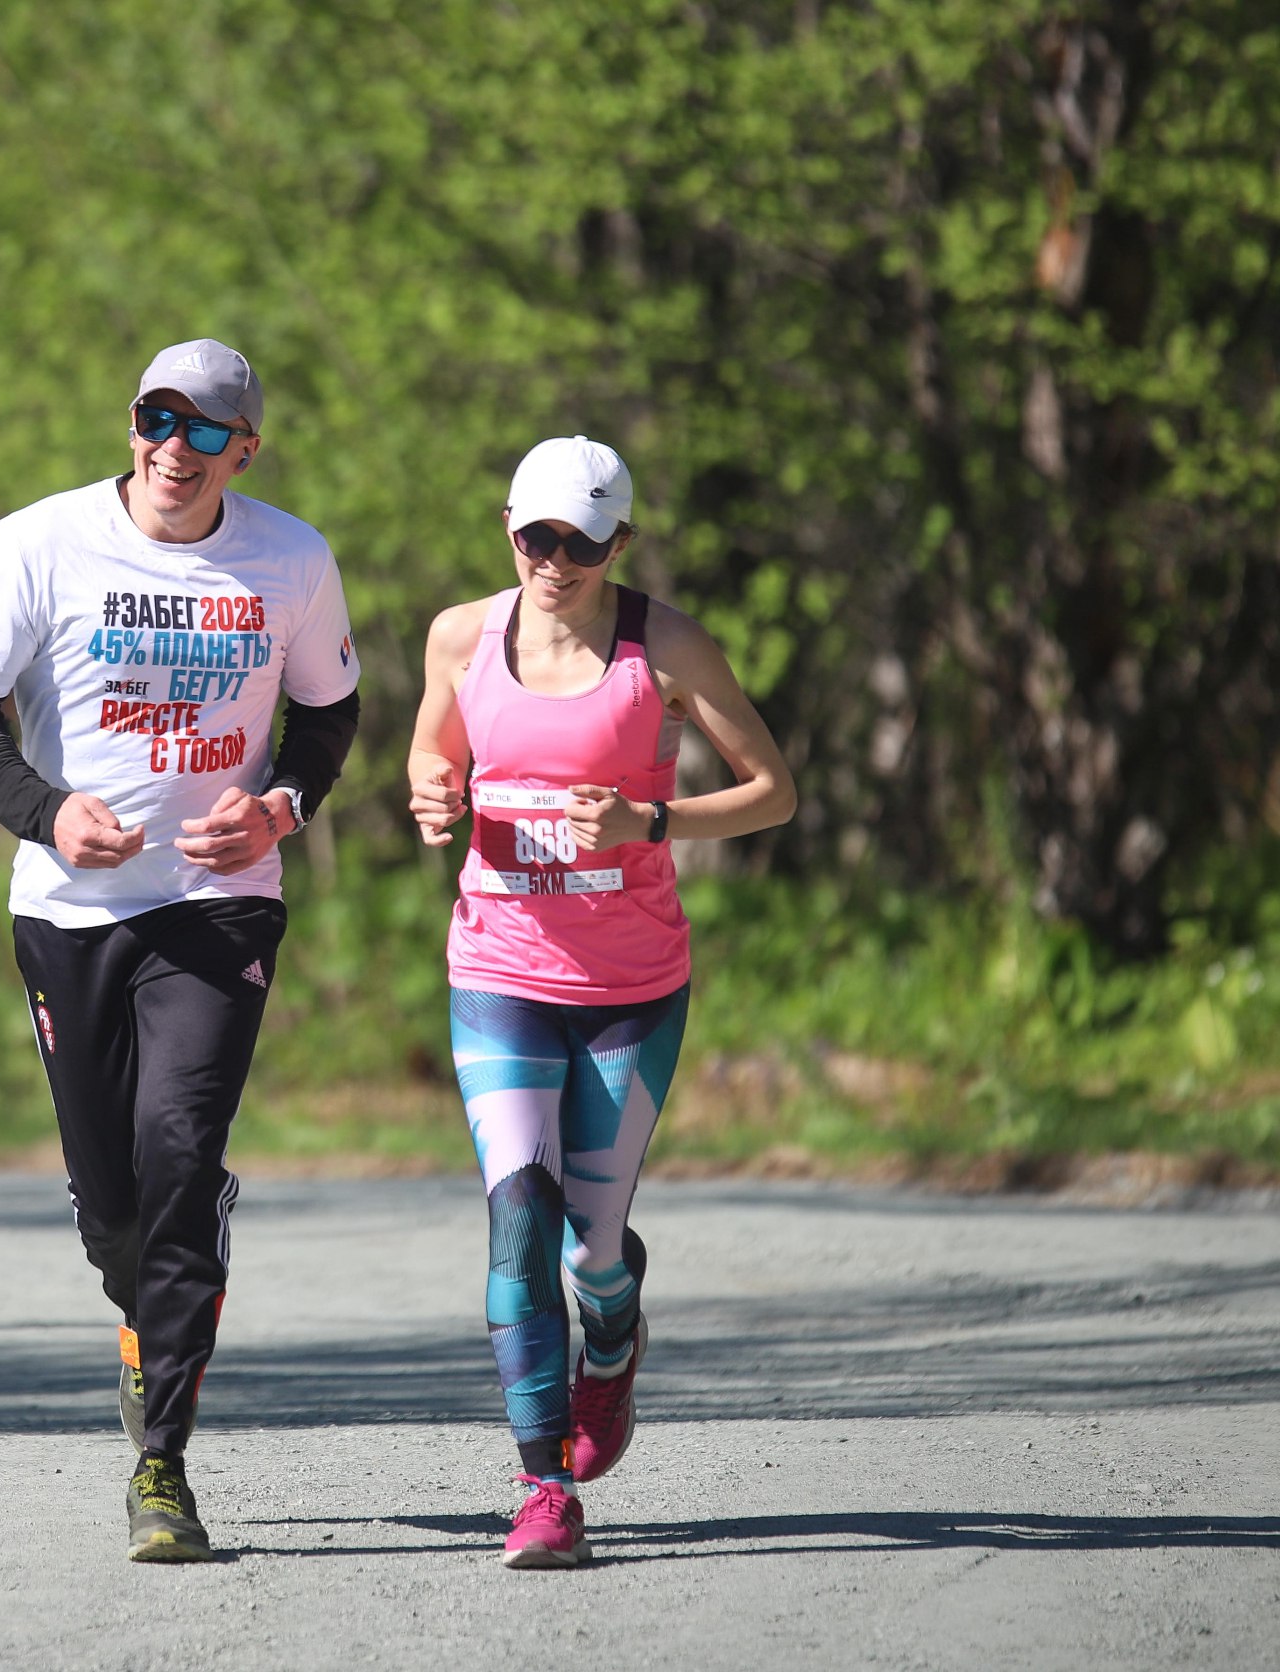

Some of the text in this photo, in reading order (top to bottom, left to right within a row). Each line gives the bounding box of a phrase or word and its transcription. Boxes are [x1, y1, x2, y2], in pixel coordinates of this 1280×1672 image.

[103, 592, 266, 631] #ЗАБЕГ2025
[88, 628, 272, 669] 45% ПЛАНЕТЫ
[168, 669, 249, 702] БЕГУТ
[631, 672, 641, 707] Reebok
[100, 699, 202, 736] ВМЕСТЕ
[150, 727, 246, 774] С ТОБОЙ
[514, 818, 577, 864] 868
[242, 972, 266, 988] adidas
